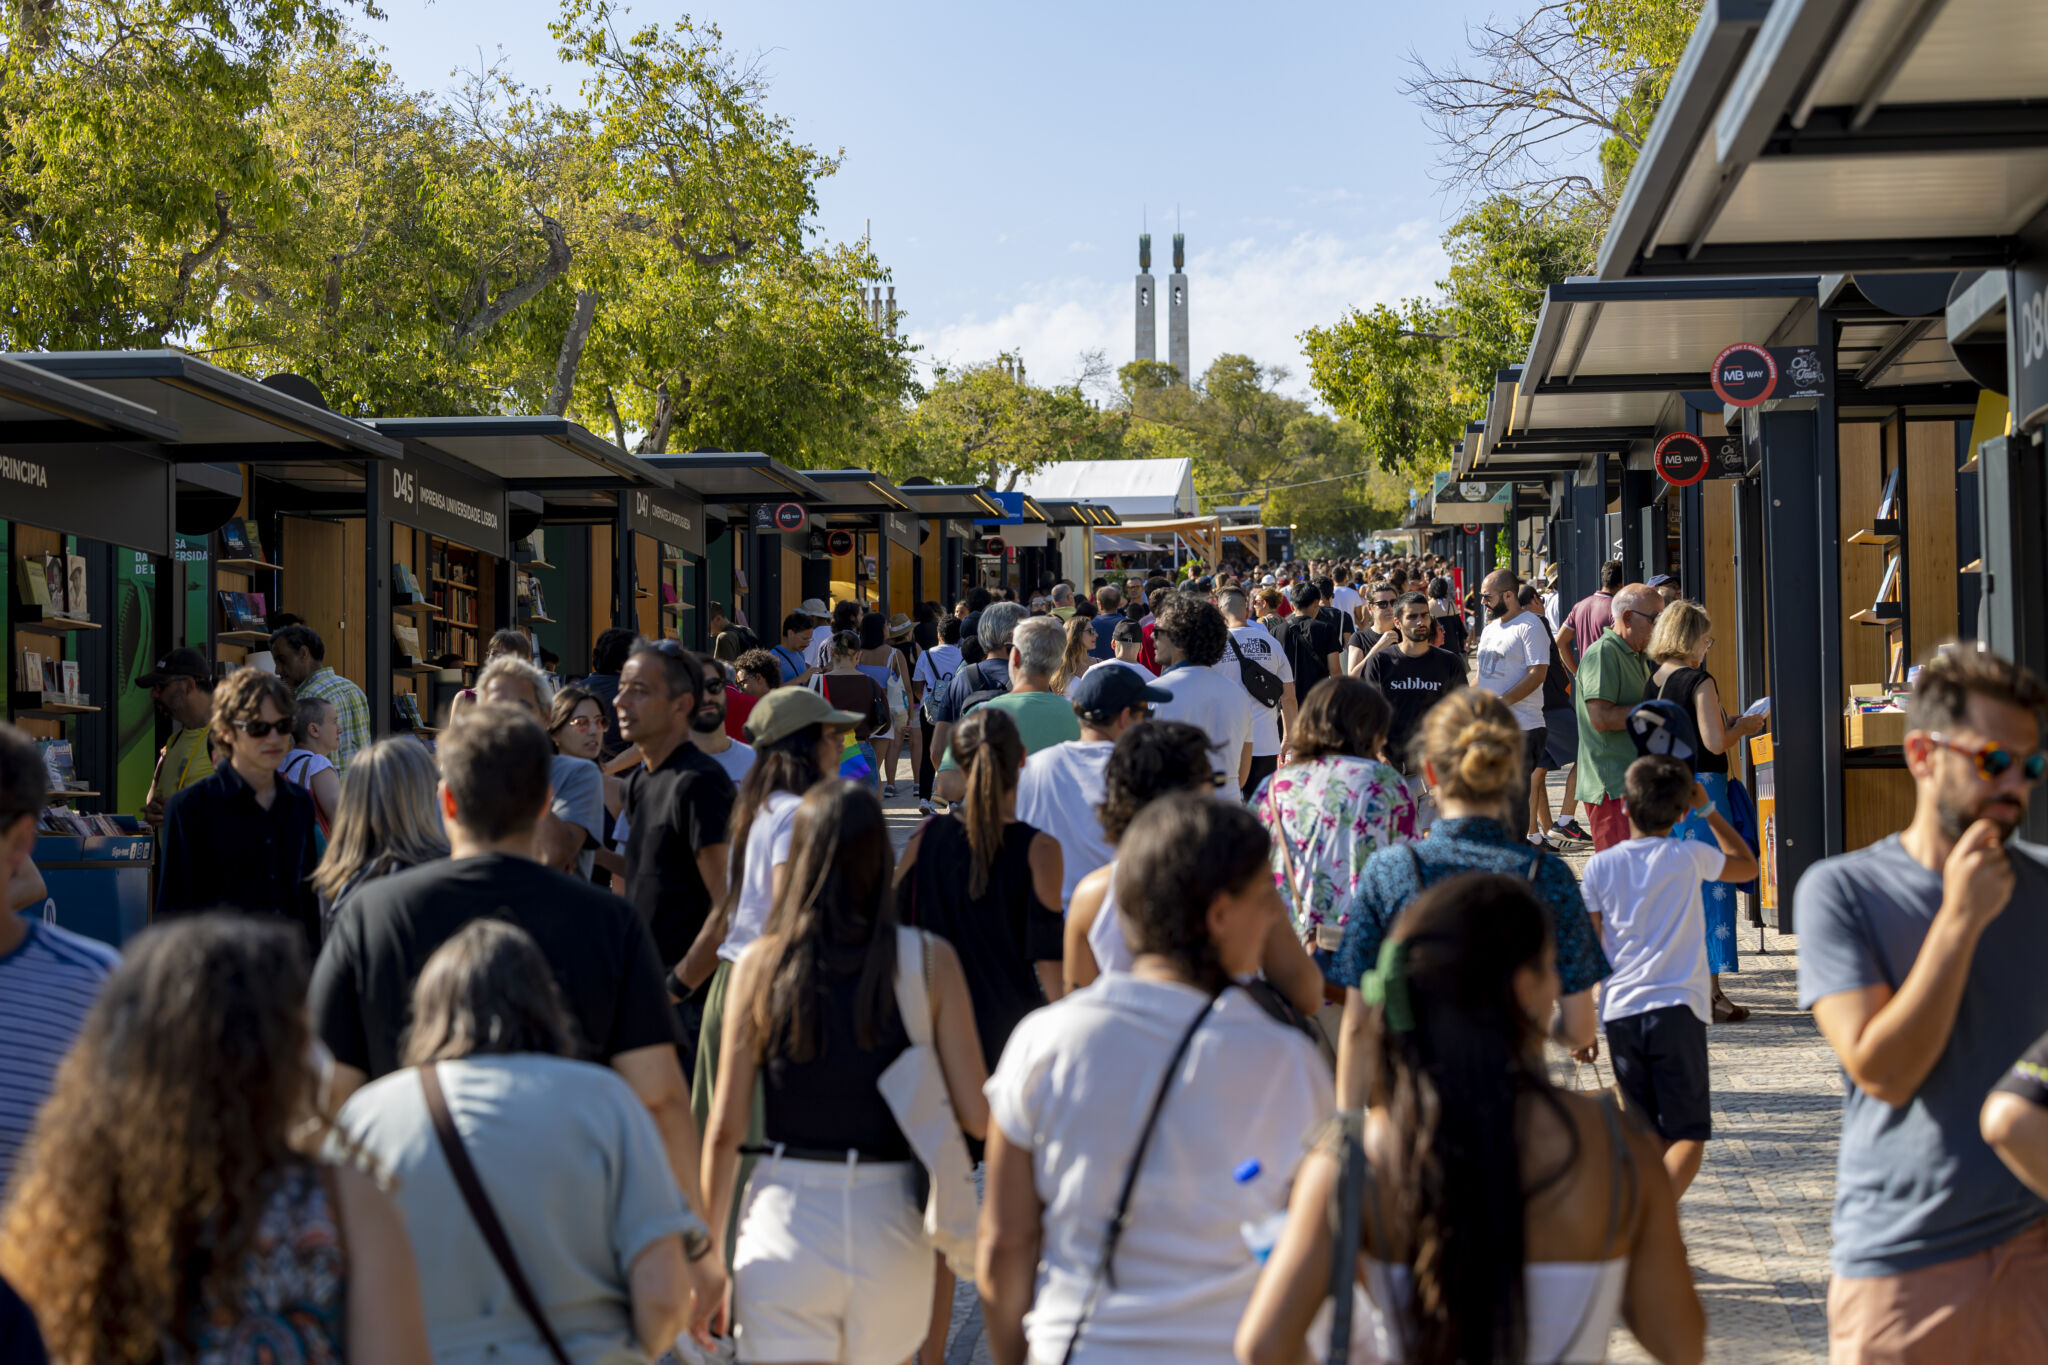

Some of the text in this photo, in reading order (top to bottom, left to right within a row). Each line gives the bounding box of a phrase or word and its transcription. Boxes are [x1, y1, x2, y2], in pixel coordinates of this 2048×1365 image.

[2022, 283, 2048, 368] D8
[1792, 357, 1808, 368] On
[1724, 370, 1764, 381] MB WAY
[1665, 456, 1682, 464] MB
[394, 468, 498, 530] D45 IMPRENSA UNIVERSIDADE LISBOA
[636, 492, 648, 517] D47
[136, 551, 208, 562] DA ERSIDA
[136, 564, 148, 574] DE
[1390, 678, 1442, 690] sabbor
